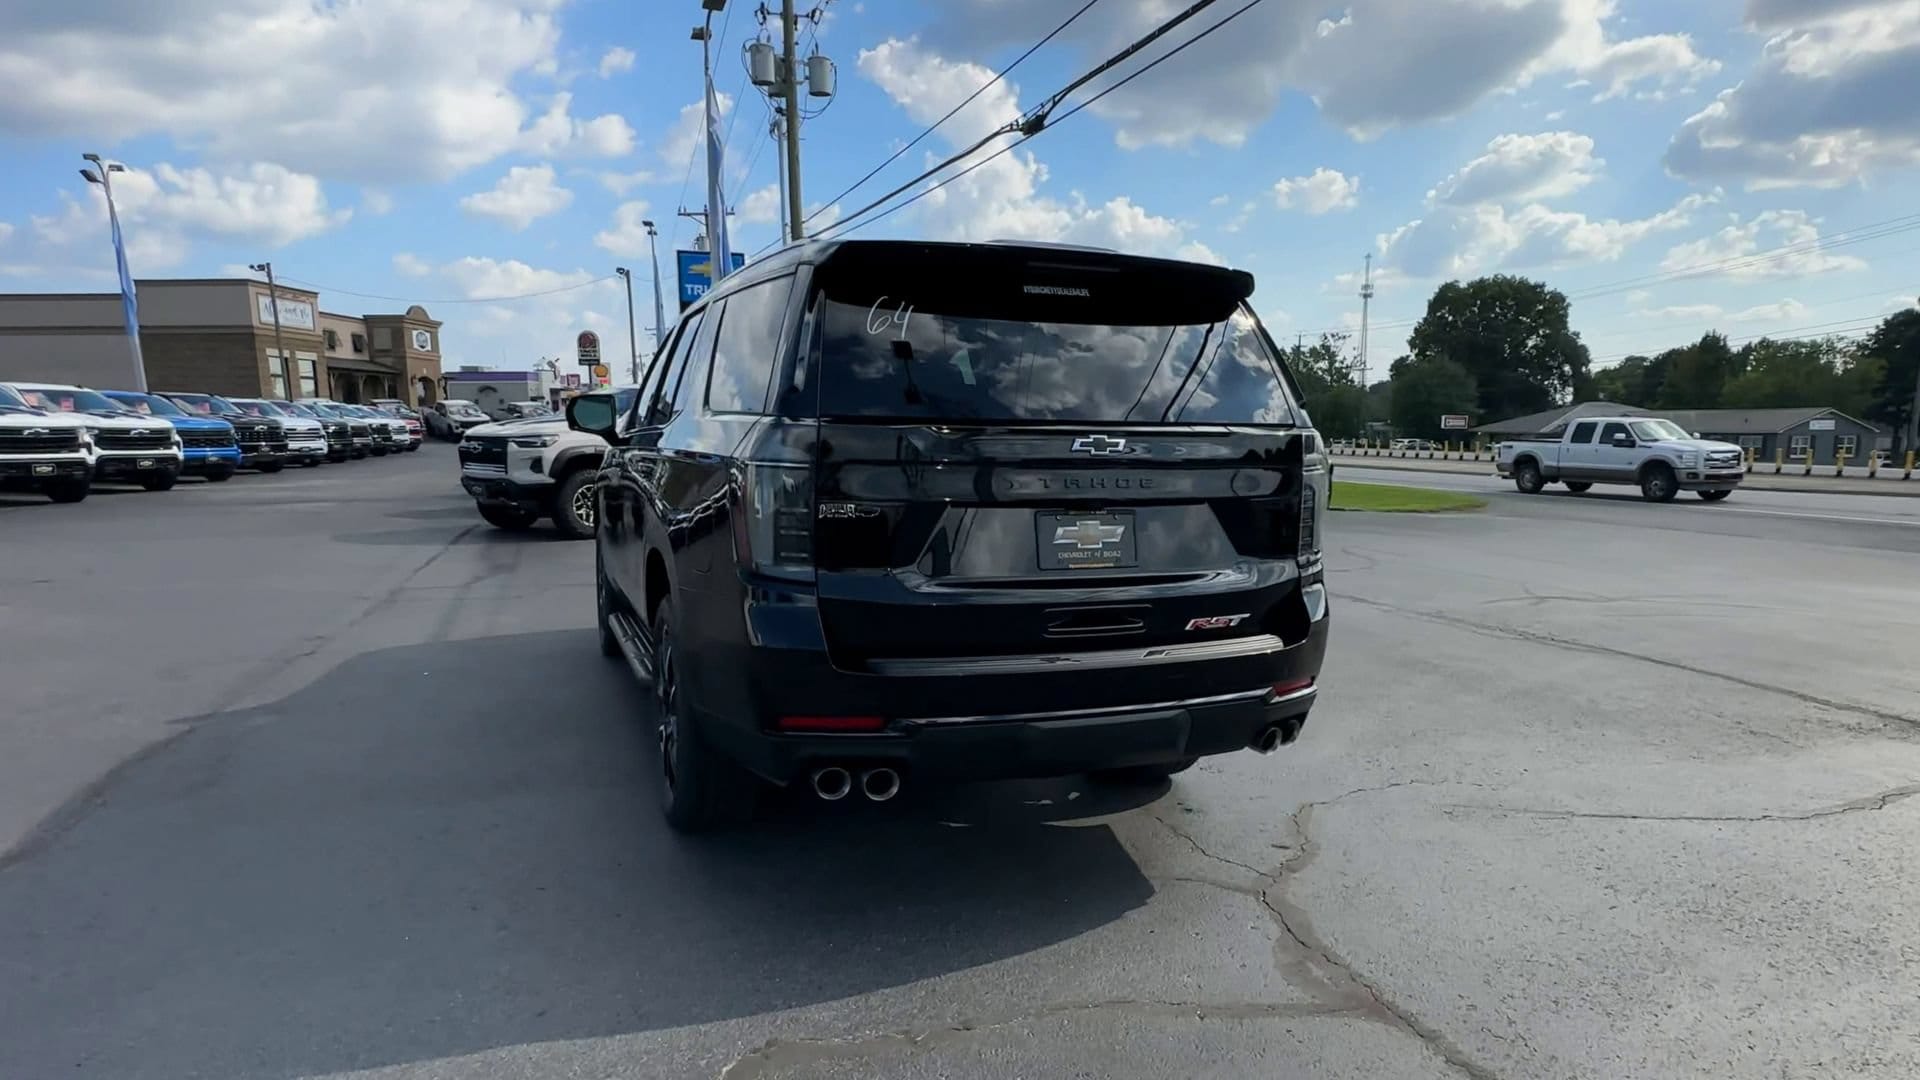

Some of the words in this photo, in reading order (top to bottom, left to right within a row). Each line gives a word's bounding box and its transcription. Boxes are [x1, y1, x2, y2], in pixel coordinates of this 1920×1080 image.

[867, 296, 914, 340] 64
[1037, 477, 1154, 489] TAHOE
[1184, 613, 1251, 630] RST
